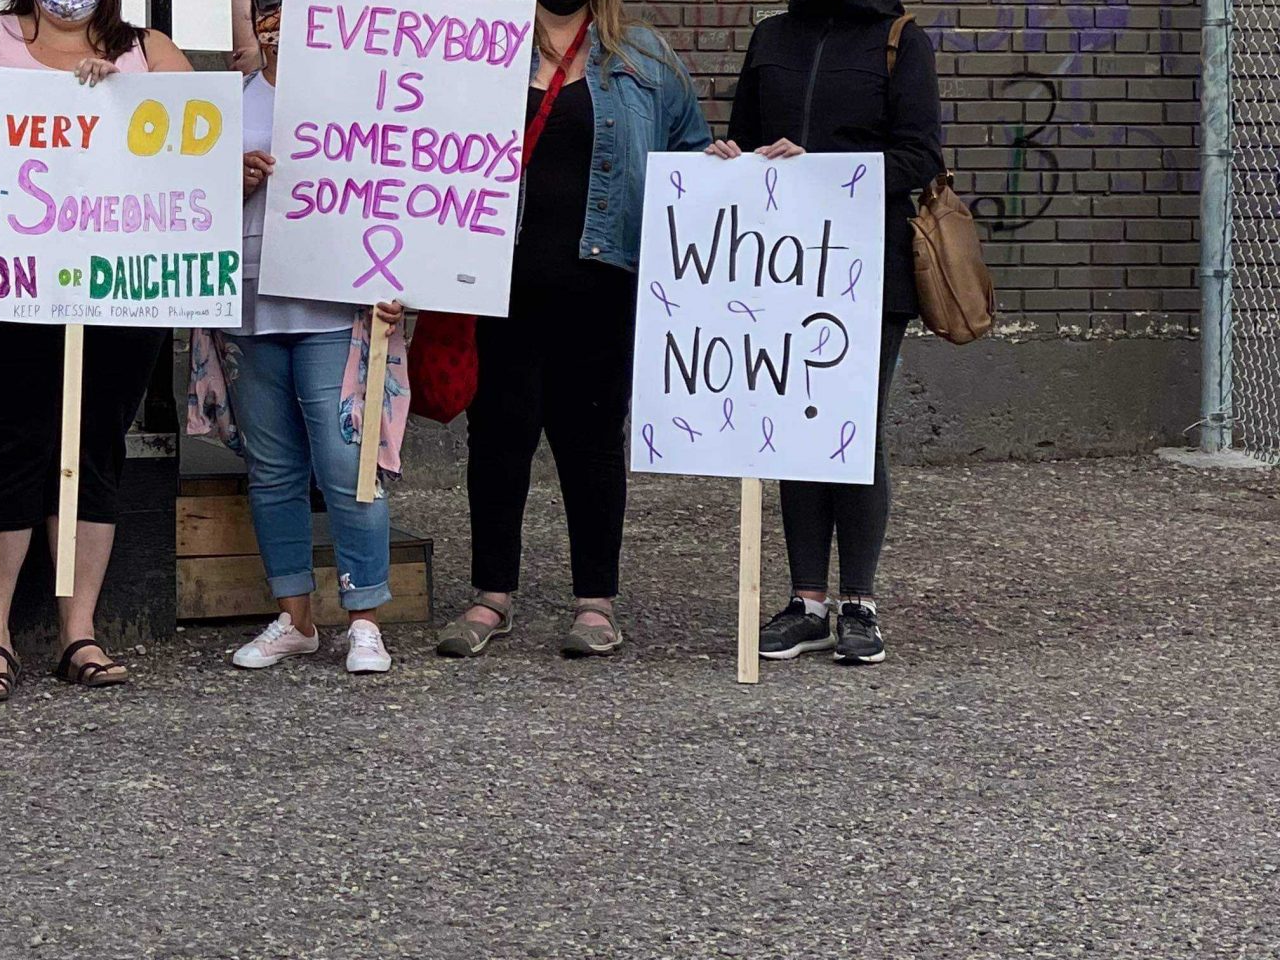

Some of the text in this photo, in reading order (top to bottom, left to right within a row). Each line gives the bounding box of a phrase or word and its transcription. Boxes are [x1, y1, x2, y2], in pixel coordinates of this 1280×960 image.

[306, 5, 531, 69] EVERYBODY
[375, 68, 425, 113] IS
[290, 121, 522, 183] SOMEBODY'S
[286, 178, 510, 236] SOMEONE
[89, 250, 240, 301] DAUGHTER
[667, 204, 850, 298] What
[13, 304, 40, 318] KEEP
[51, 304, 102, 318] PRESSING
[110, 304, 159, 318] FORWARD
